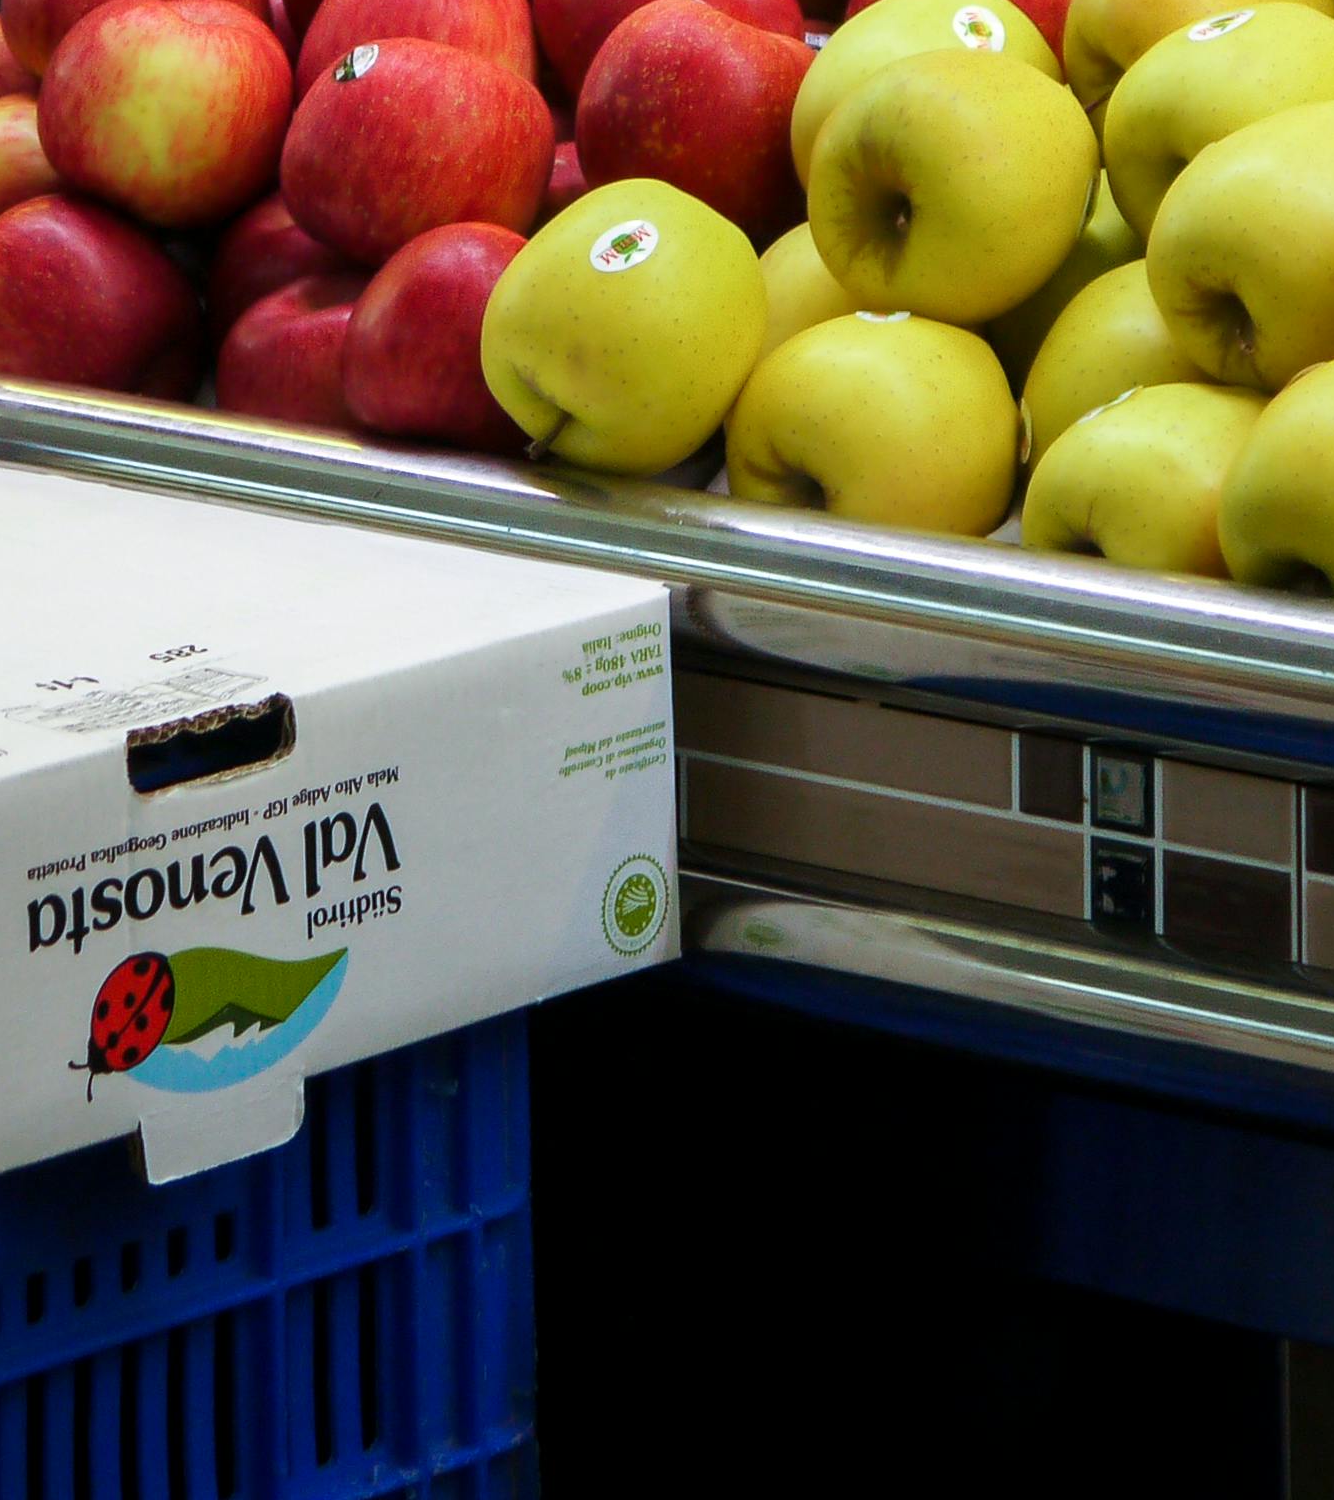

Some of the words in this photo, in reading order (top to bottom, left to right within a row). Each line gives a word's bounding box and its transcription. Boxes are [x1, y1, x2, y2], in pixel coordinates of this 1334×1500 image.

[582, 636, 612, 655] Italia
[631, 644, 663, 665] TARA
[596, 655, 627, 673] 480g
[334, 775, 363, 795] Alto
[366, 765, 399, 786] Mela
[262, 793, 289, 820] IGP
[292, 783, 331, 807] Adige
[172, 808, 250, 842] Indicazione
[90, 832, 167, 865] Geografica
[304, 802, 401, 899] Val
[27, 857, 87, 882] Protetta
[27, 835, 291, 955] Venosta
[307, 885, 402, 939] Südtirol
